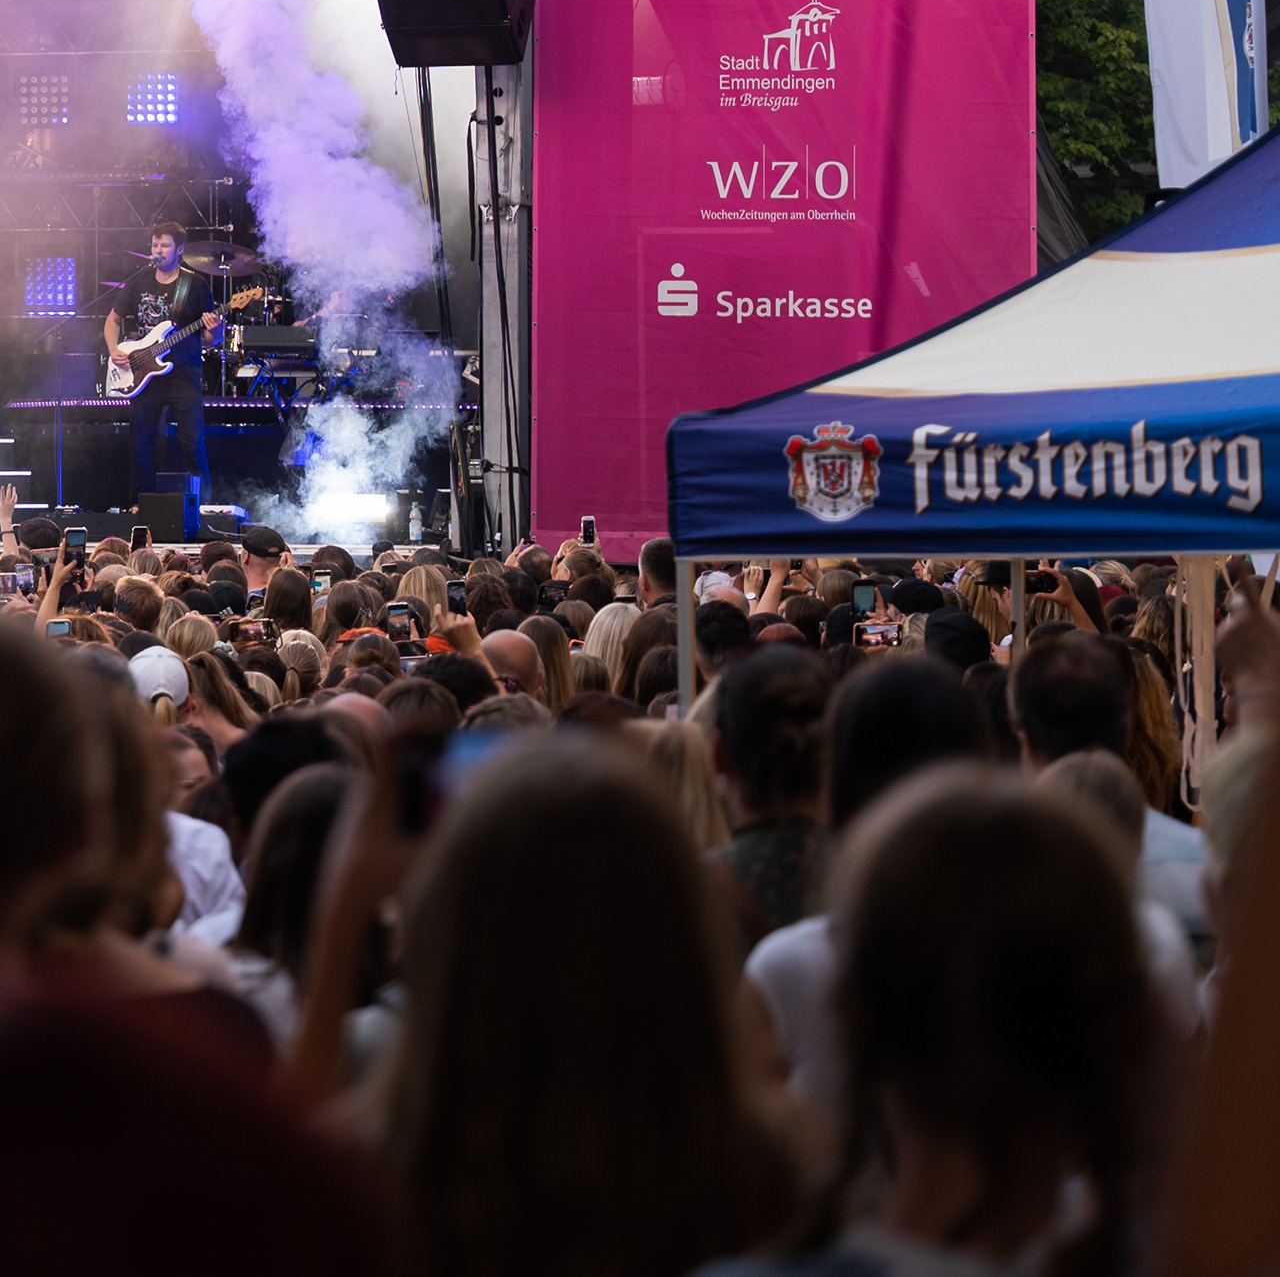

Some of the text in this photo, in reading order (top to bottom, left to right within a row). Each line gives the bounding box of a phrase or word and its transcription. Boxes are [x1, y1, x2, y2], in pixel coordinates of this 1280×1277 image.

[719, 55, 760, 70] Stadt
[719, 74, 836, 93] Emmendingen
[719, 93, 799, 111] im Breisgau
[700, 209, 856, 222] WochenZeitungen am Oberrhein
[716, 290, 873, 324] Sparkasse
[906, 420, 1264, 516] Fürstenberg
